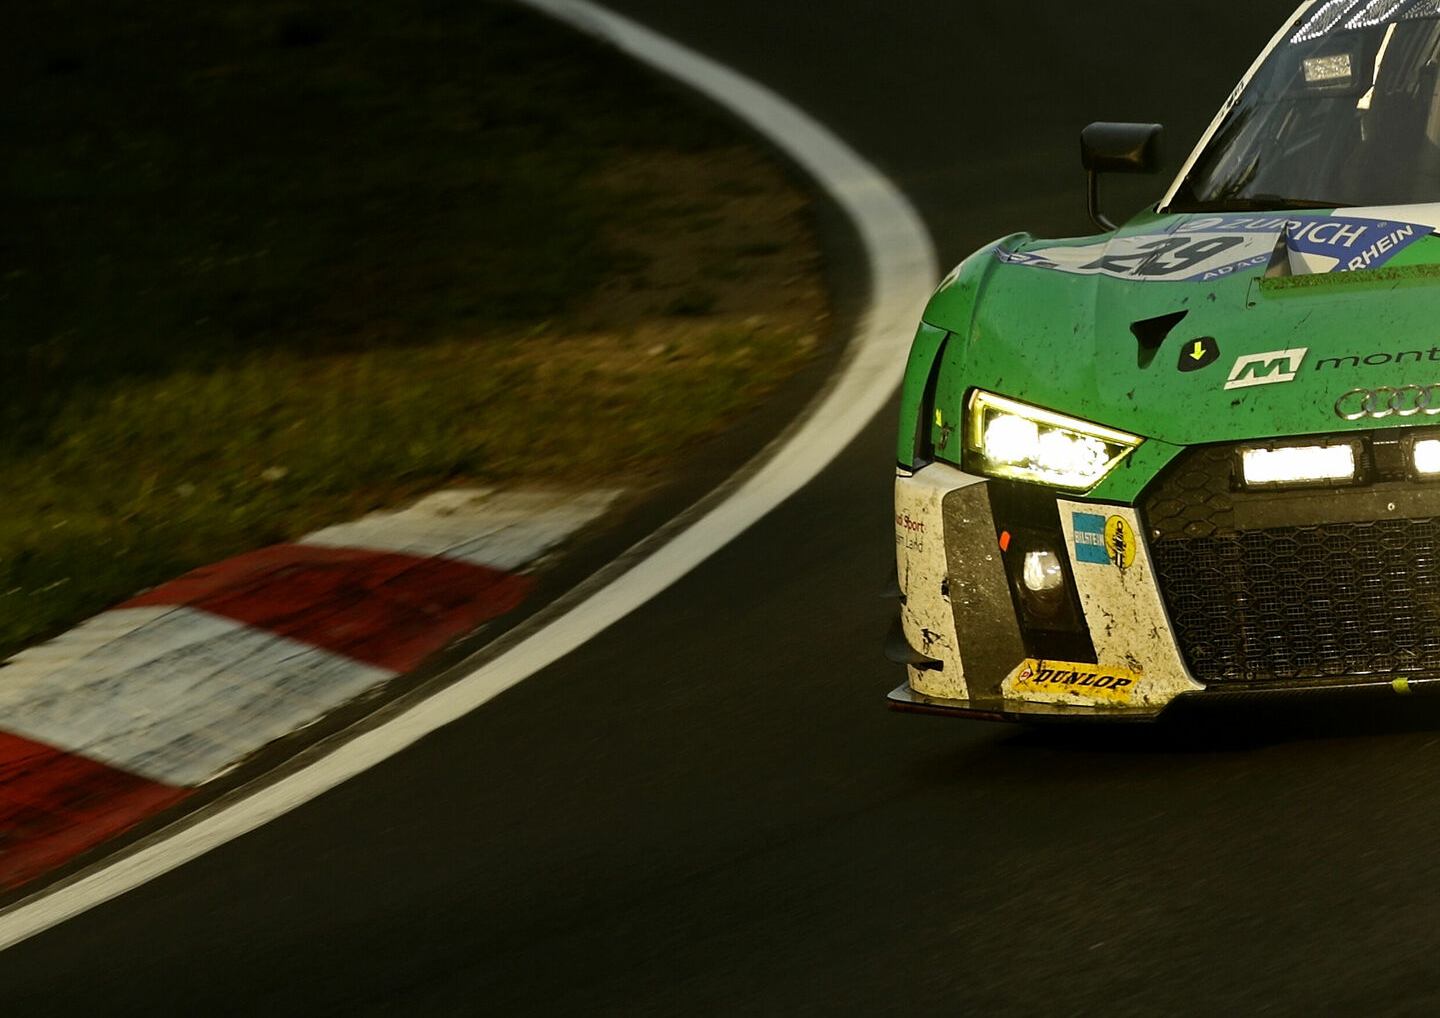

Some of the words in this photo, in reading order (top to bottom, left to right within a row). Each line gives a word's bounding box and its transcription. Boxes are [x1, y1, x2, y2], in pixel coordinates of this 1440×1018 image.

[1203, 256, 1267, 280] ADAC
[1340, 225, 1414, 272] RHEIN
[1074, 531, 1105, 546] BILSTEIN
[1033, 669, 1132, 690] DUNLOP
